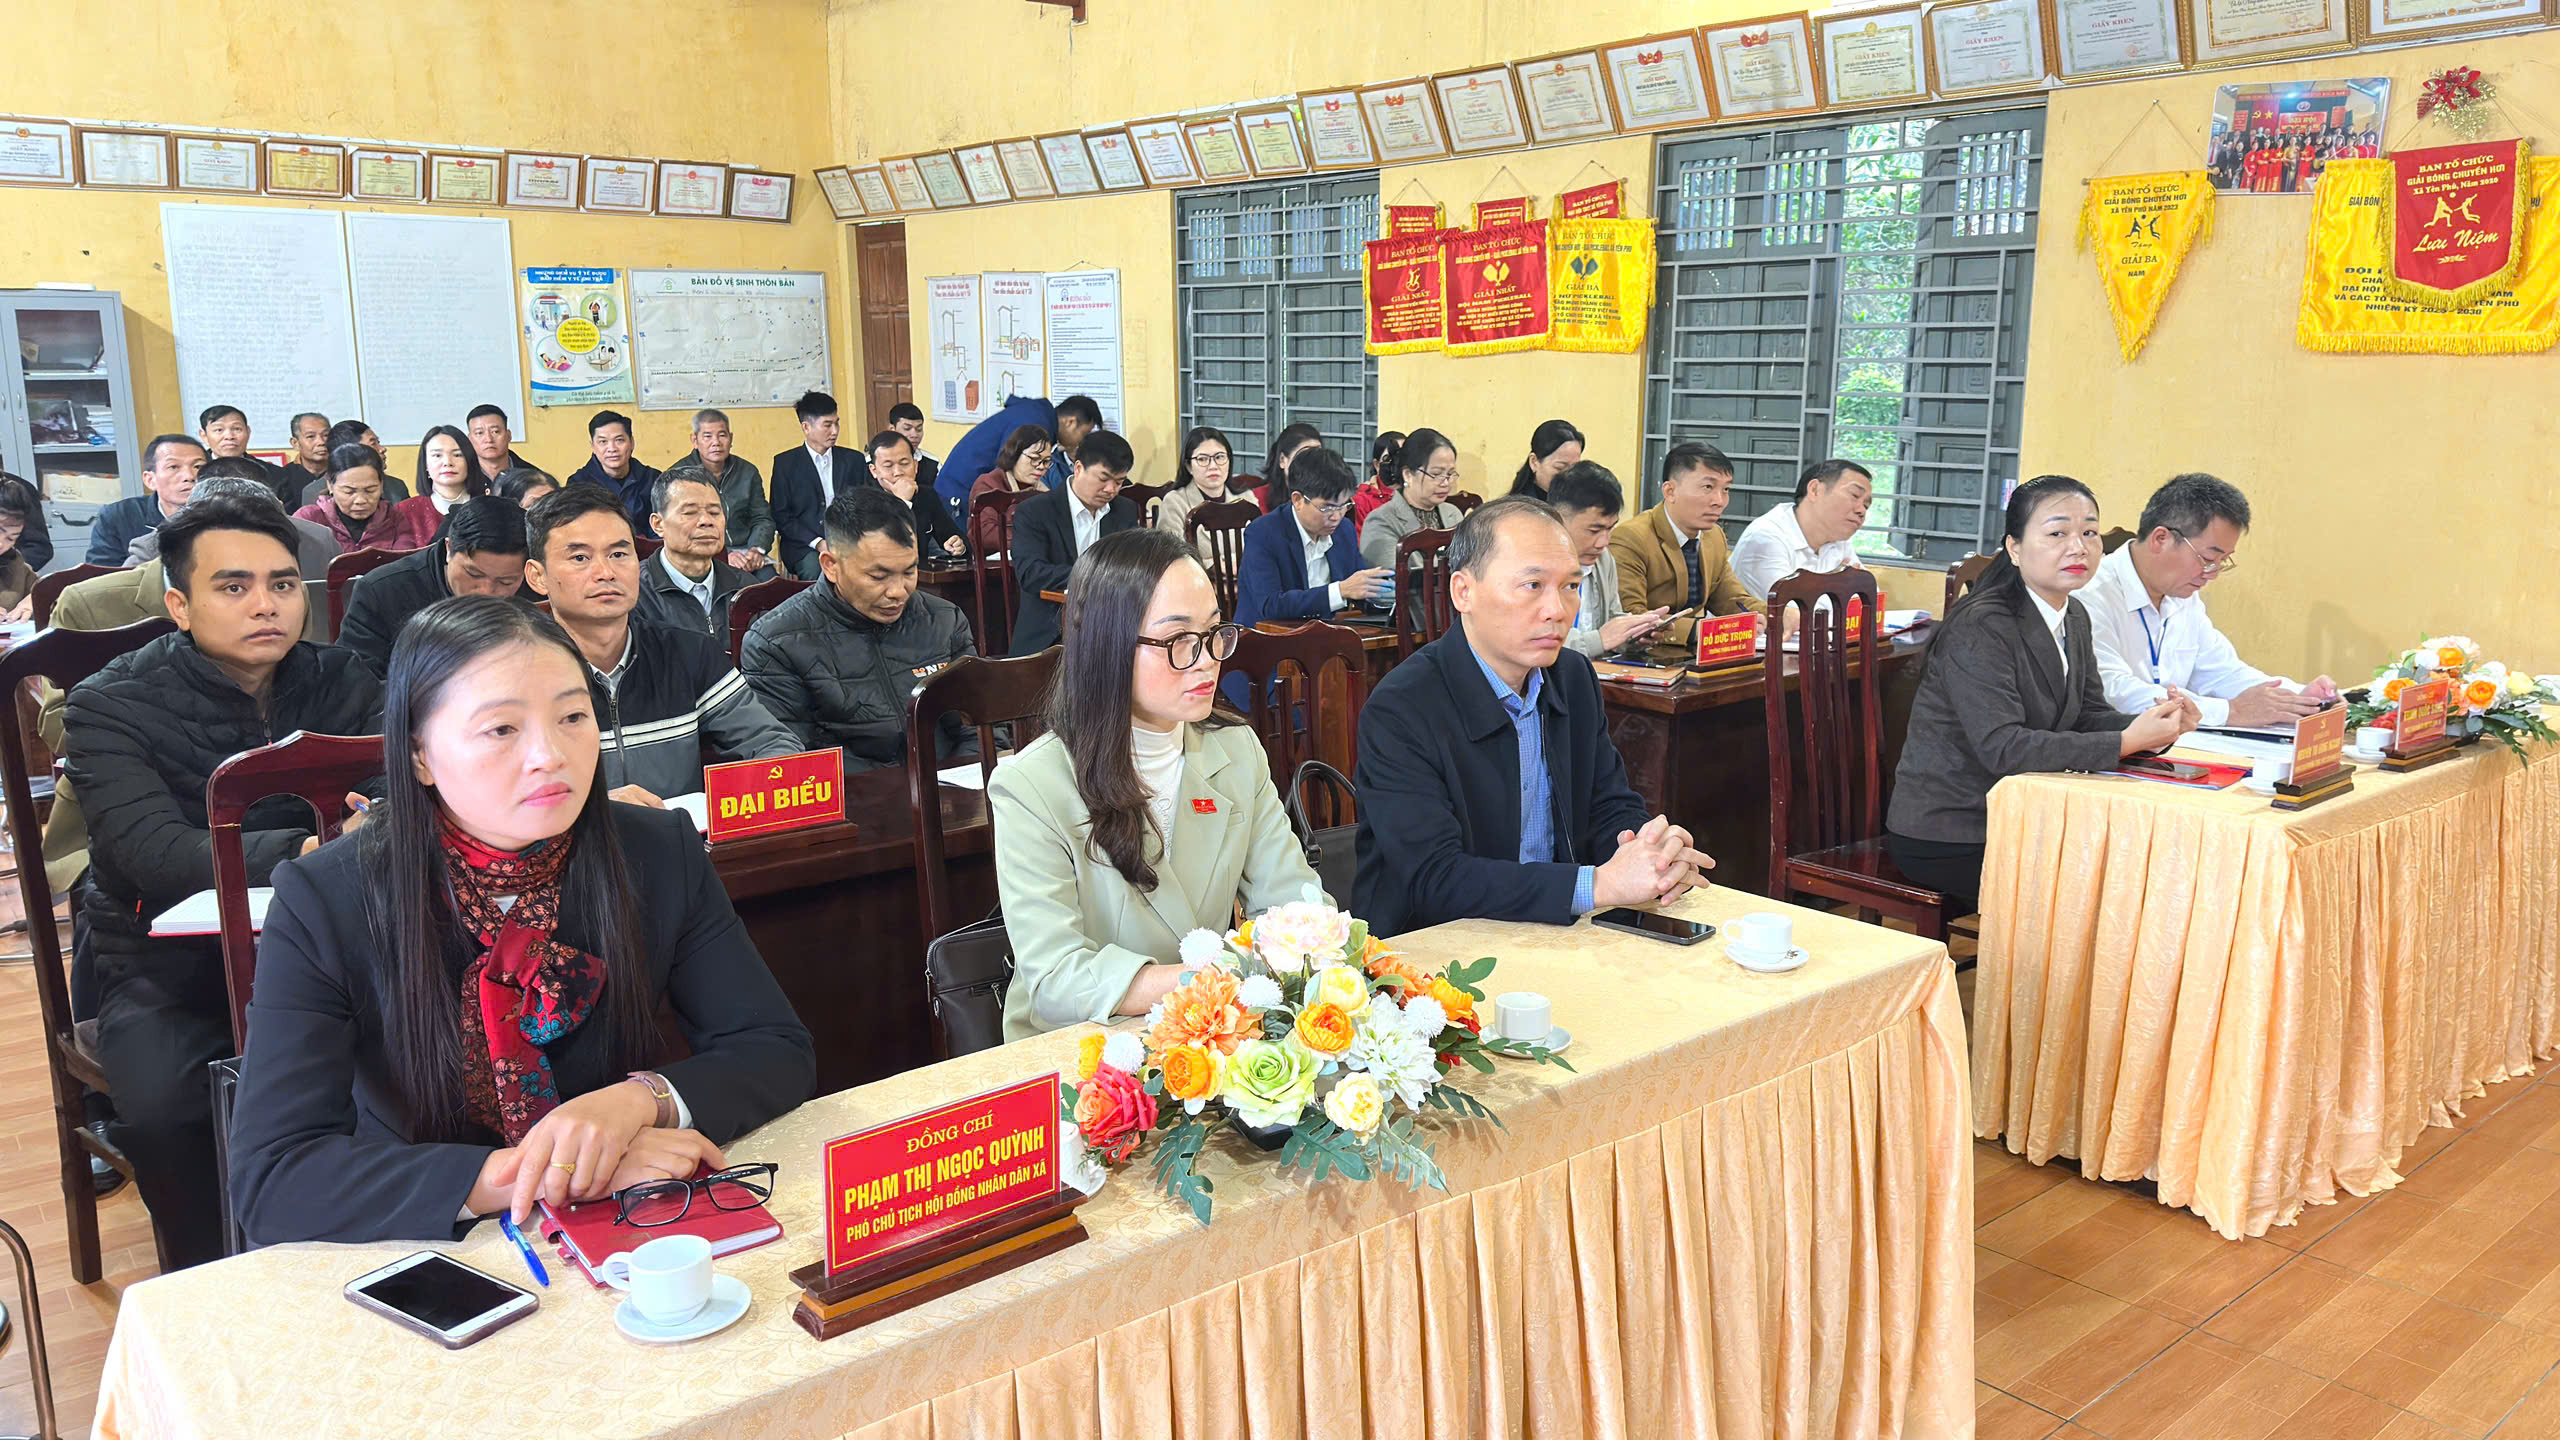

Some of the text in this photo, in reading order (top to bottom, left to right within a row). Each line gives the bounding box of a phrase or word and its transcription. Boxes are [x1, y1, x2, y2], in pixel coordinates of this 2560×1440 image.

[2419, 155, 2494, 173] BAN TỔ CHỨC
[2407, 174, 2425, 186] GIẢI
[2426, 171, 2451, 183] BÓNG
[2489, 163, 2506, 173] HƠI
[2113, 184, 2179, 196] BAN TỔ CHỨC
[2104, 196, 2119, 205] GIẢI
[2349, 193, 2362, 206] GIẢI
[2364, 196, 2380, 206] BÓN
[2413, 228, 2499, 253] Lưu Niệm
[2121, 253, 2142, 264] GIẢI
[691, 275, 795, 287] BẢN ĐỒ VỆ SINH THÔN BẢN
[1474, 284, 1517, 299] GIẢI NHẤT
[2365, 303, 2401, 312] NHIỆM
[1730, 629, 1752, 642] TRỌNG
[720, 775, 832, 820] ĐẠI BIỂU
[905, 1109, 993, 1153] ĐỒNG CHÍ
[844, 1125, 1044, 1214] PHẠM THỊ NGỌC QUỲNH
[847, 1159, 1046, 1244] PHÓ CHỦ TỊCH HỘI ĐỒNG NHÂN DÂN XÃ
